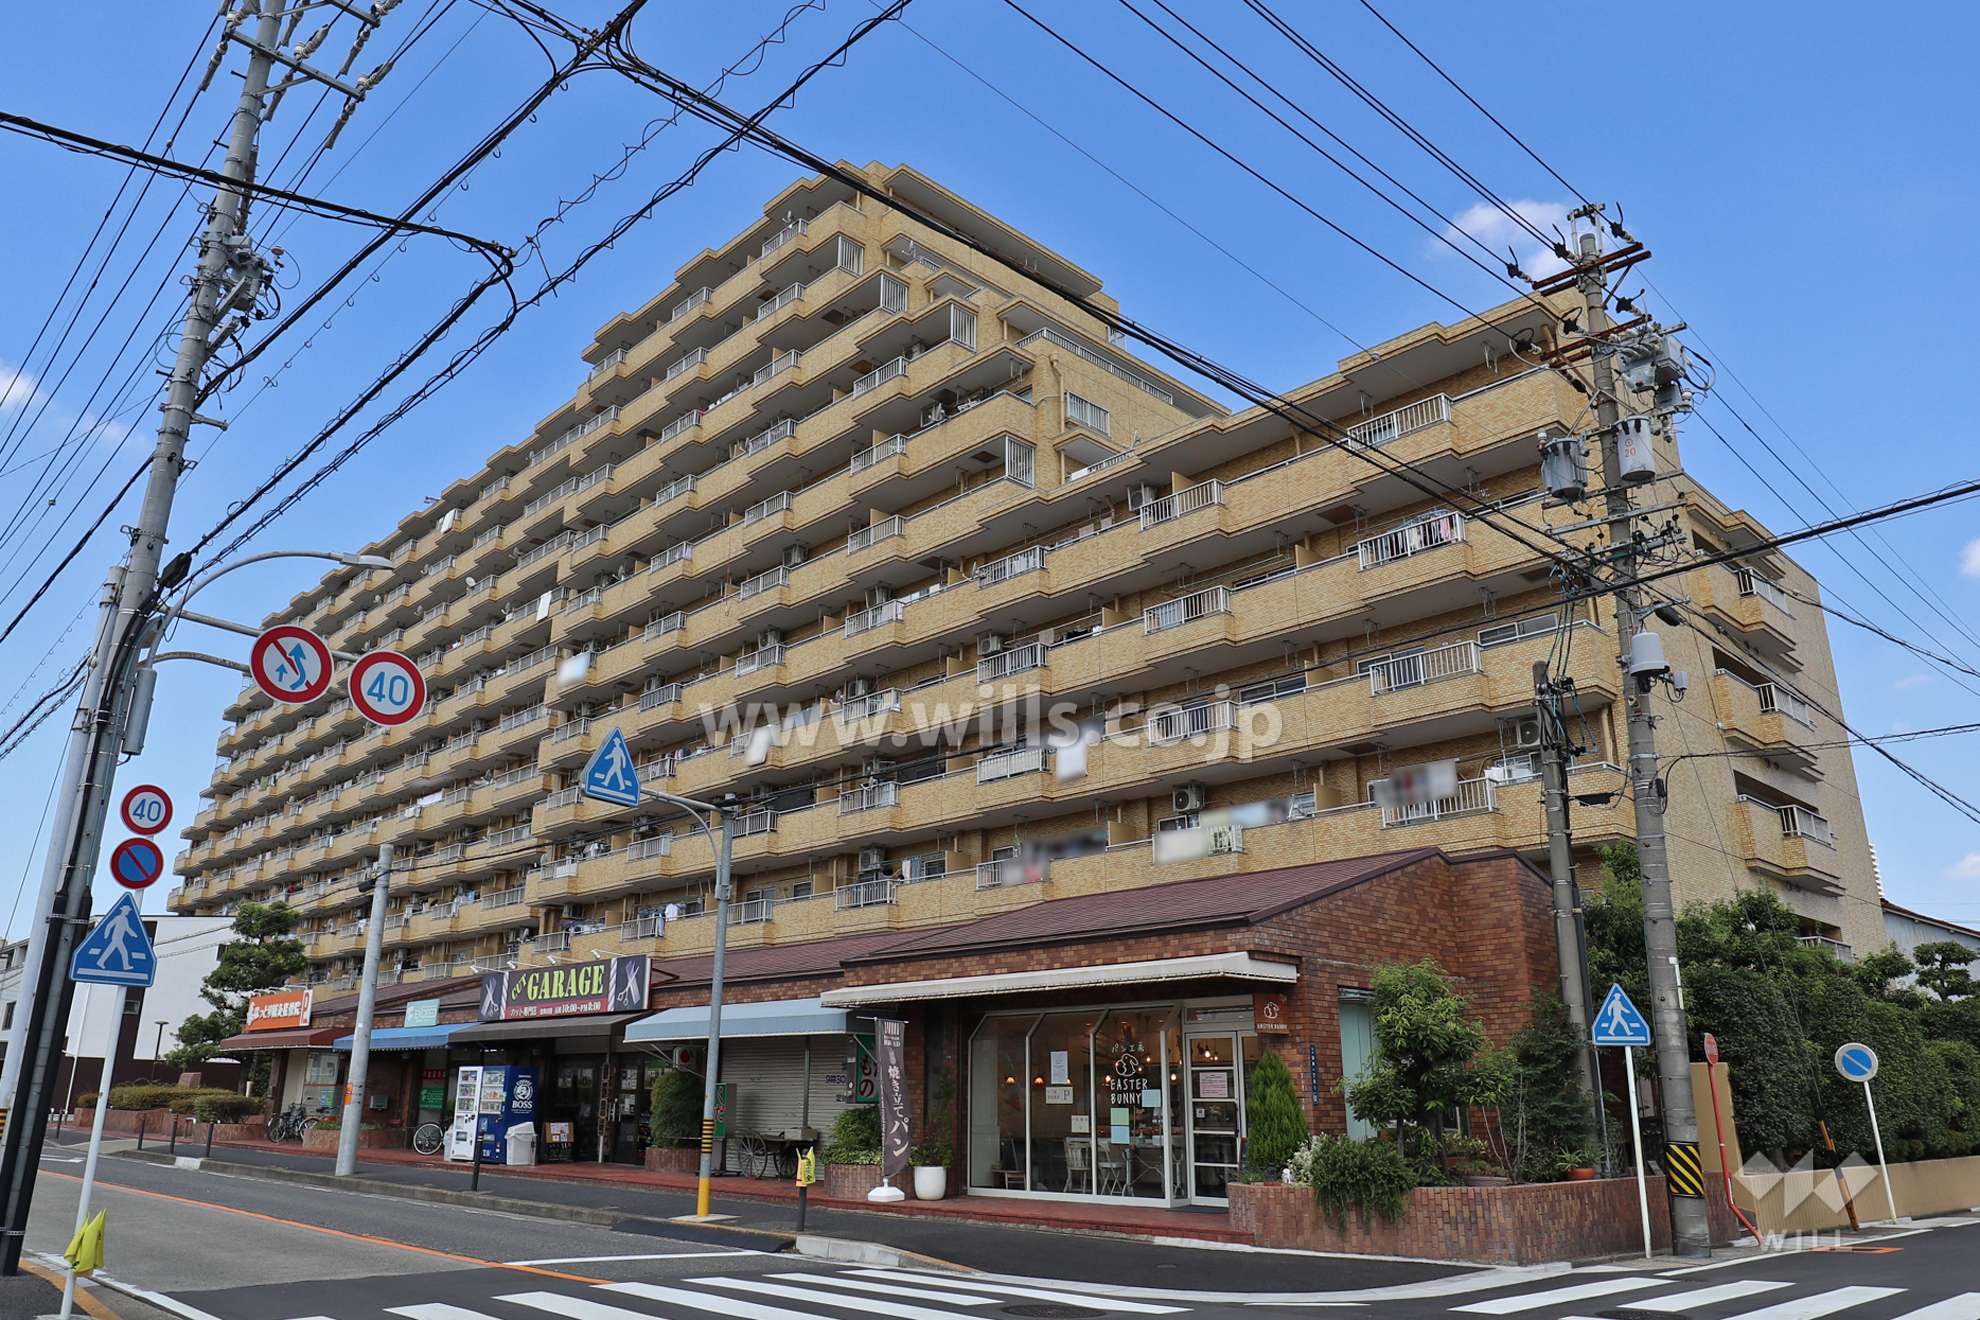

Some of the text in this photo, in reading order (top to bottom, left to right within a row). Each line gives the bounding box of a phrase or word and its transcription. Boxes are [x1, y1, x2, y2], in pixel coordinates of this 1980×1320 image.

[1624, 447, 1637, 458] 20
[366, 671, 409, 706] 40
[132, 798, 162, 822] 40
[511, 965, 605, 1001] CUT GARAGE
[1110, 1078, 1149, 1090] EASTER
[512, 1100, 533, 1109] BOSS
[887, 1064, 910, 1157] 焼き立てパン
